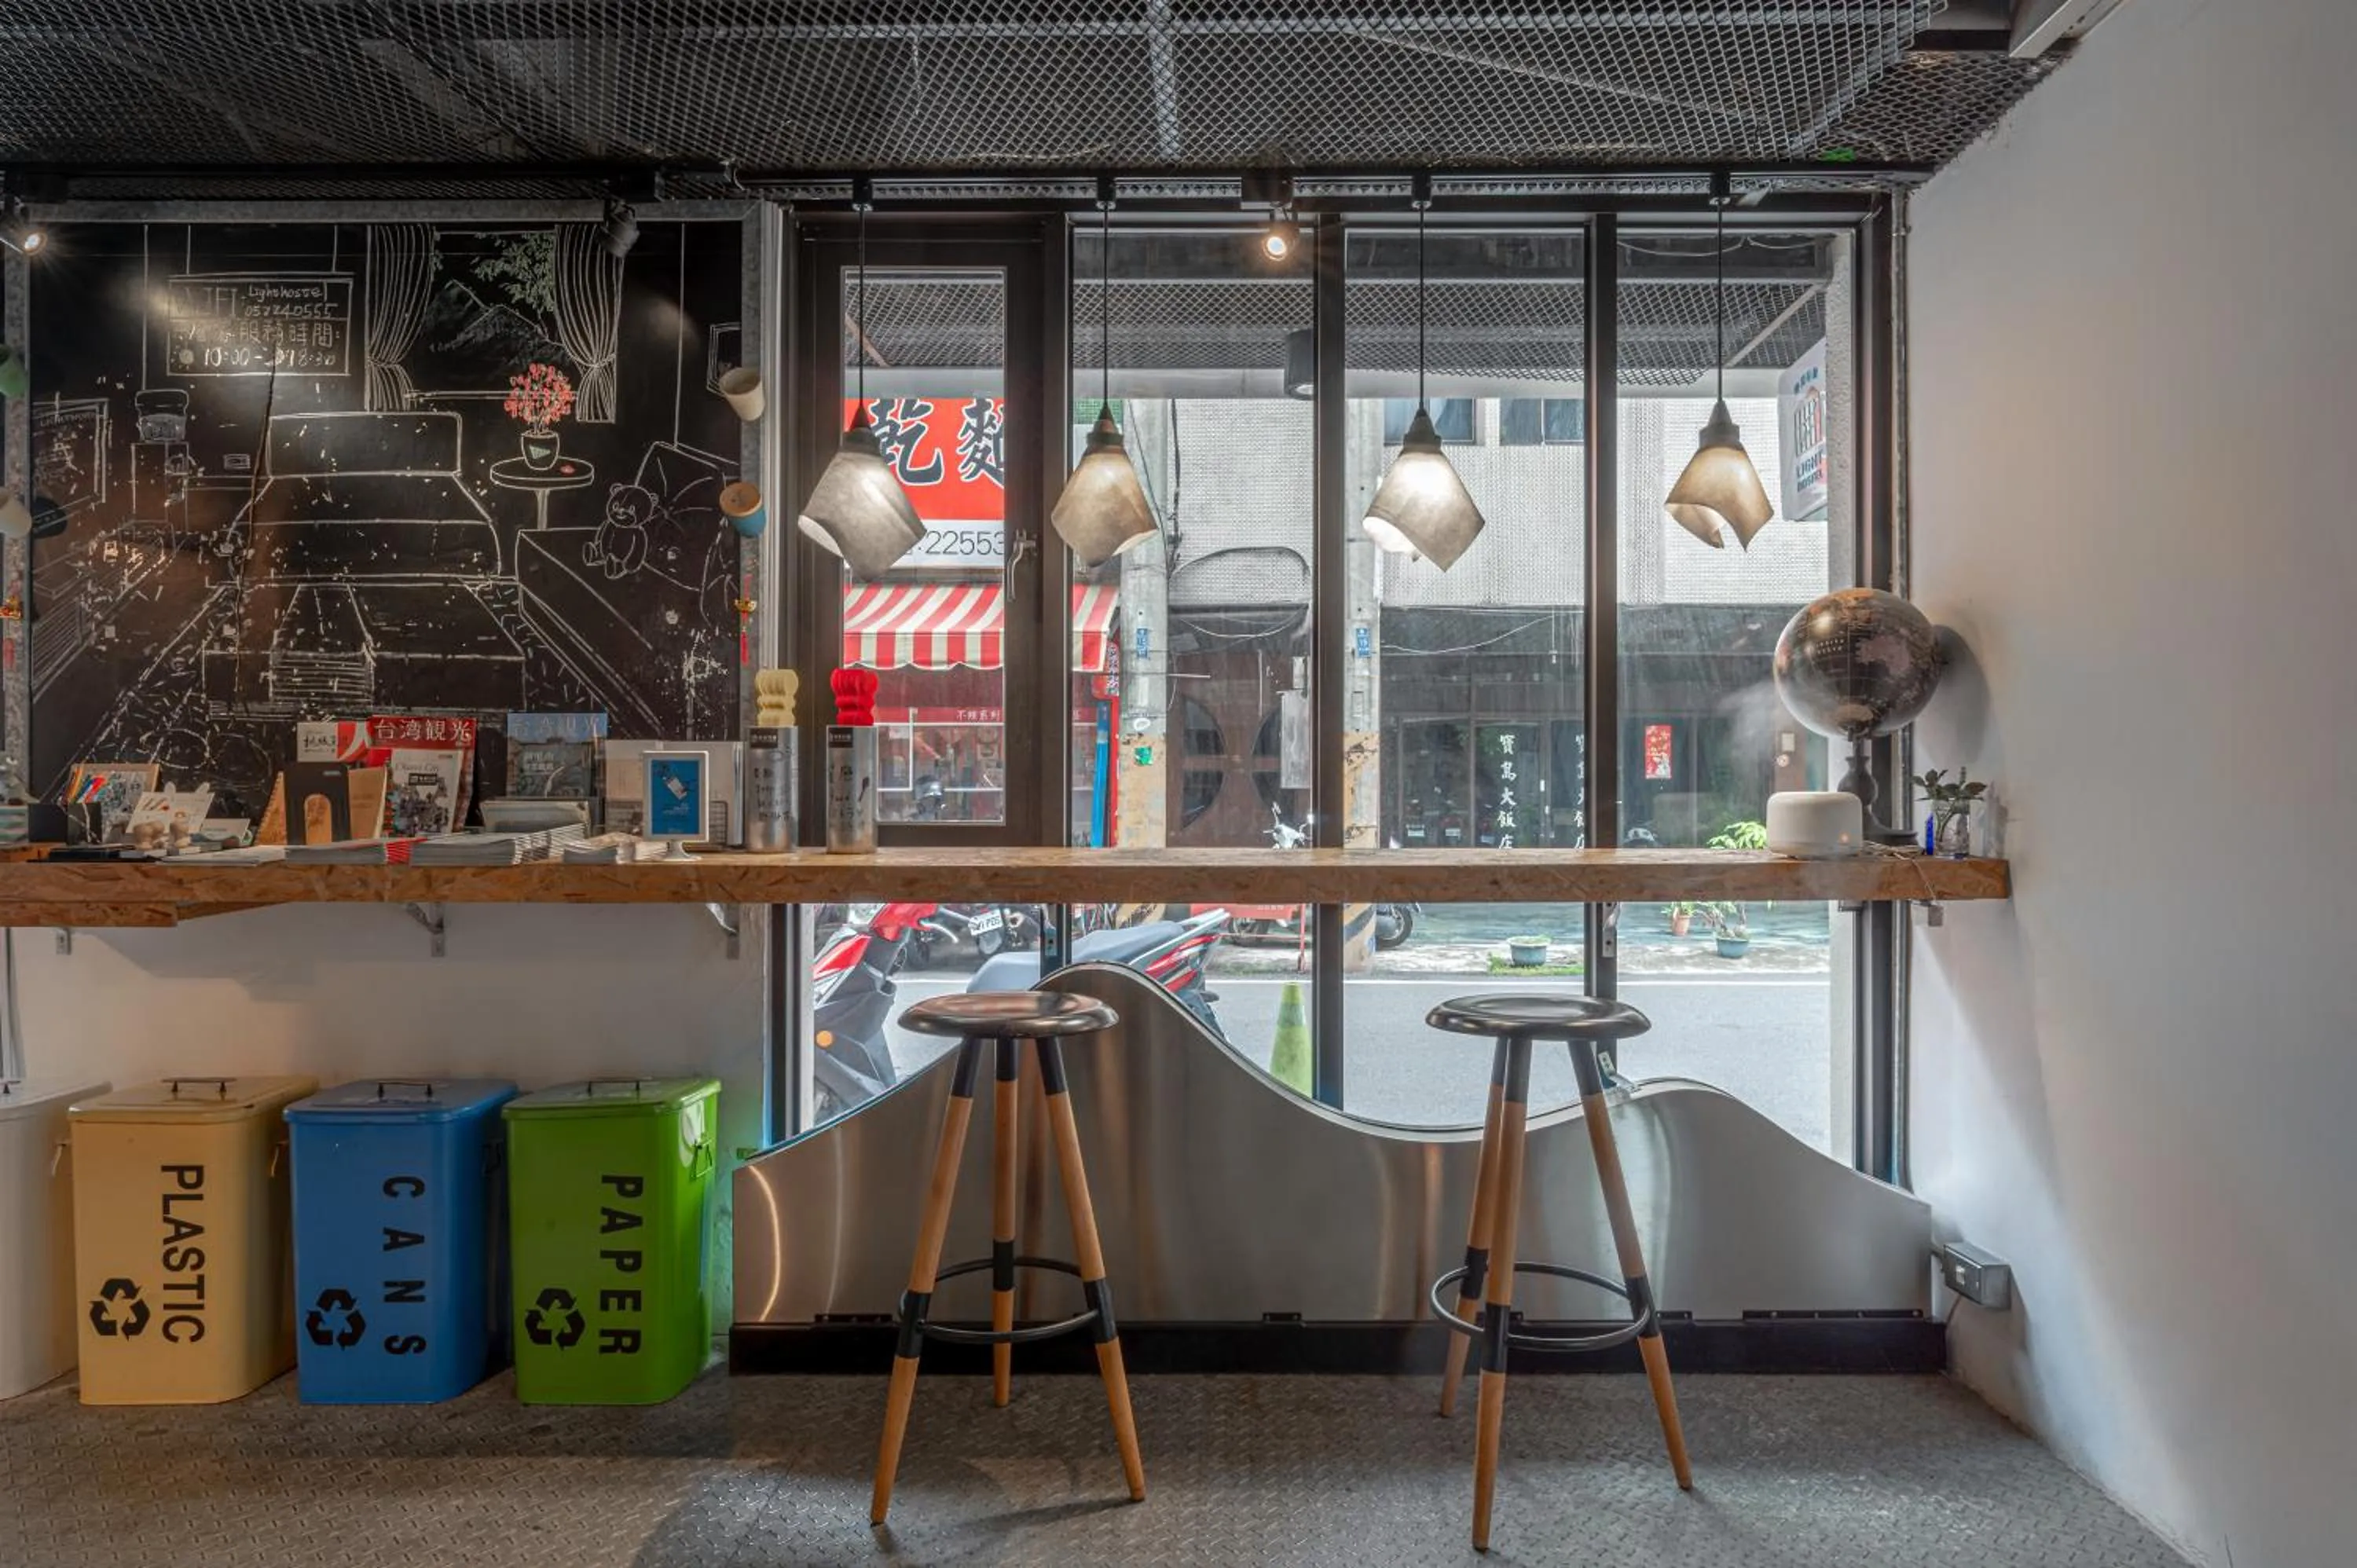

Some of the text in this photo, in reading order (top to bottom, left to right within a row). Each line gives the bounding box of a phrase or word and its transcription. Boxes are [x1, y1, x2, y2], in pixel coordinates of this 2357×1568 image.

[1795, 449, 1824, 479] LIGHT
[374, 719, 472, 742] 台湾観光
[160, 1163, 206, 1344] PLASTIC
[382, 1176, 426, 1357] CANS
[600, 1174, 644, 1355] PAPER
